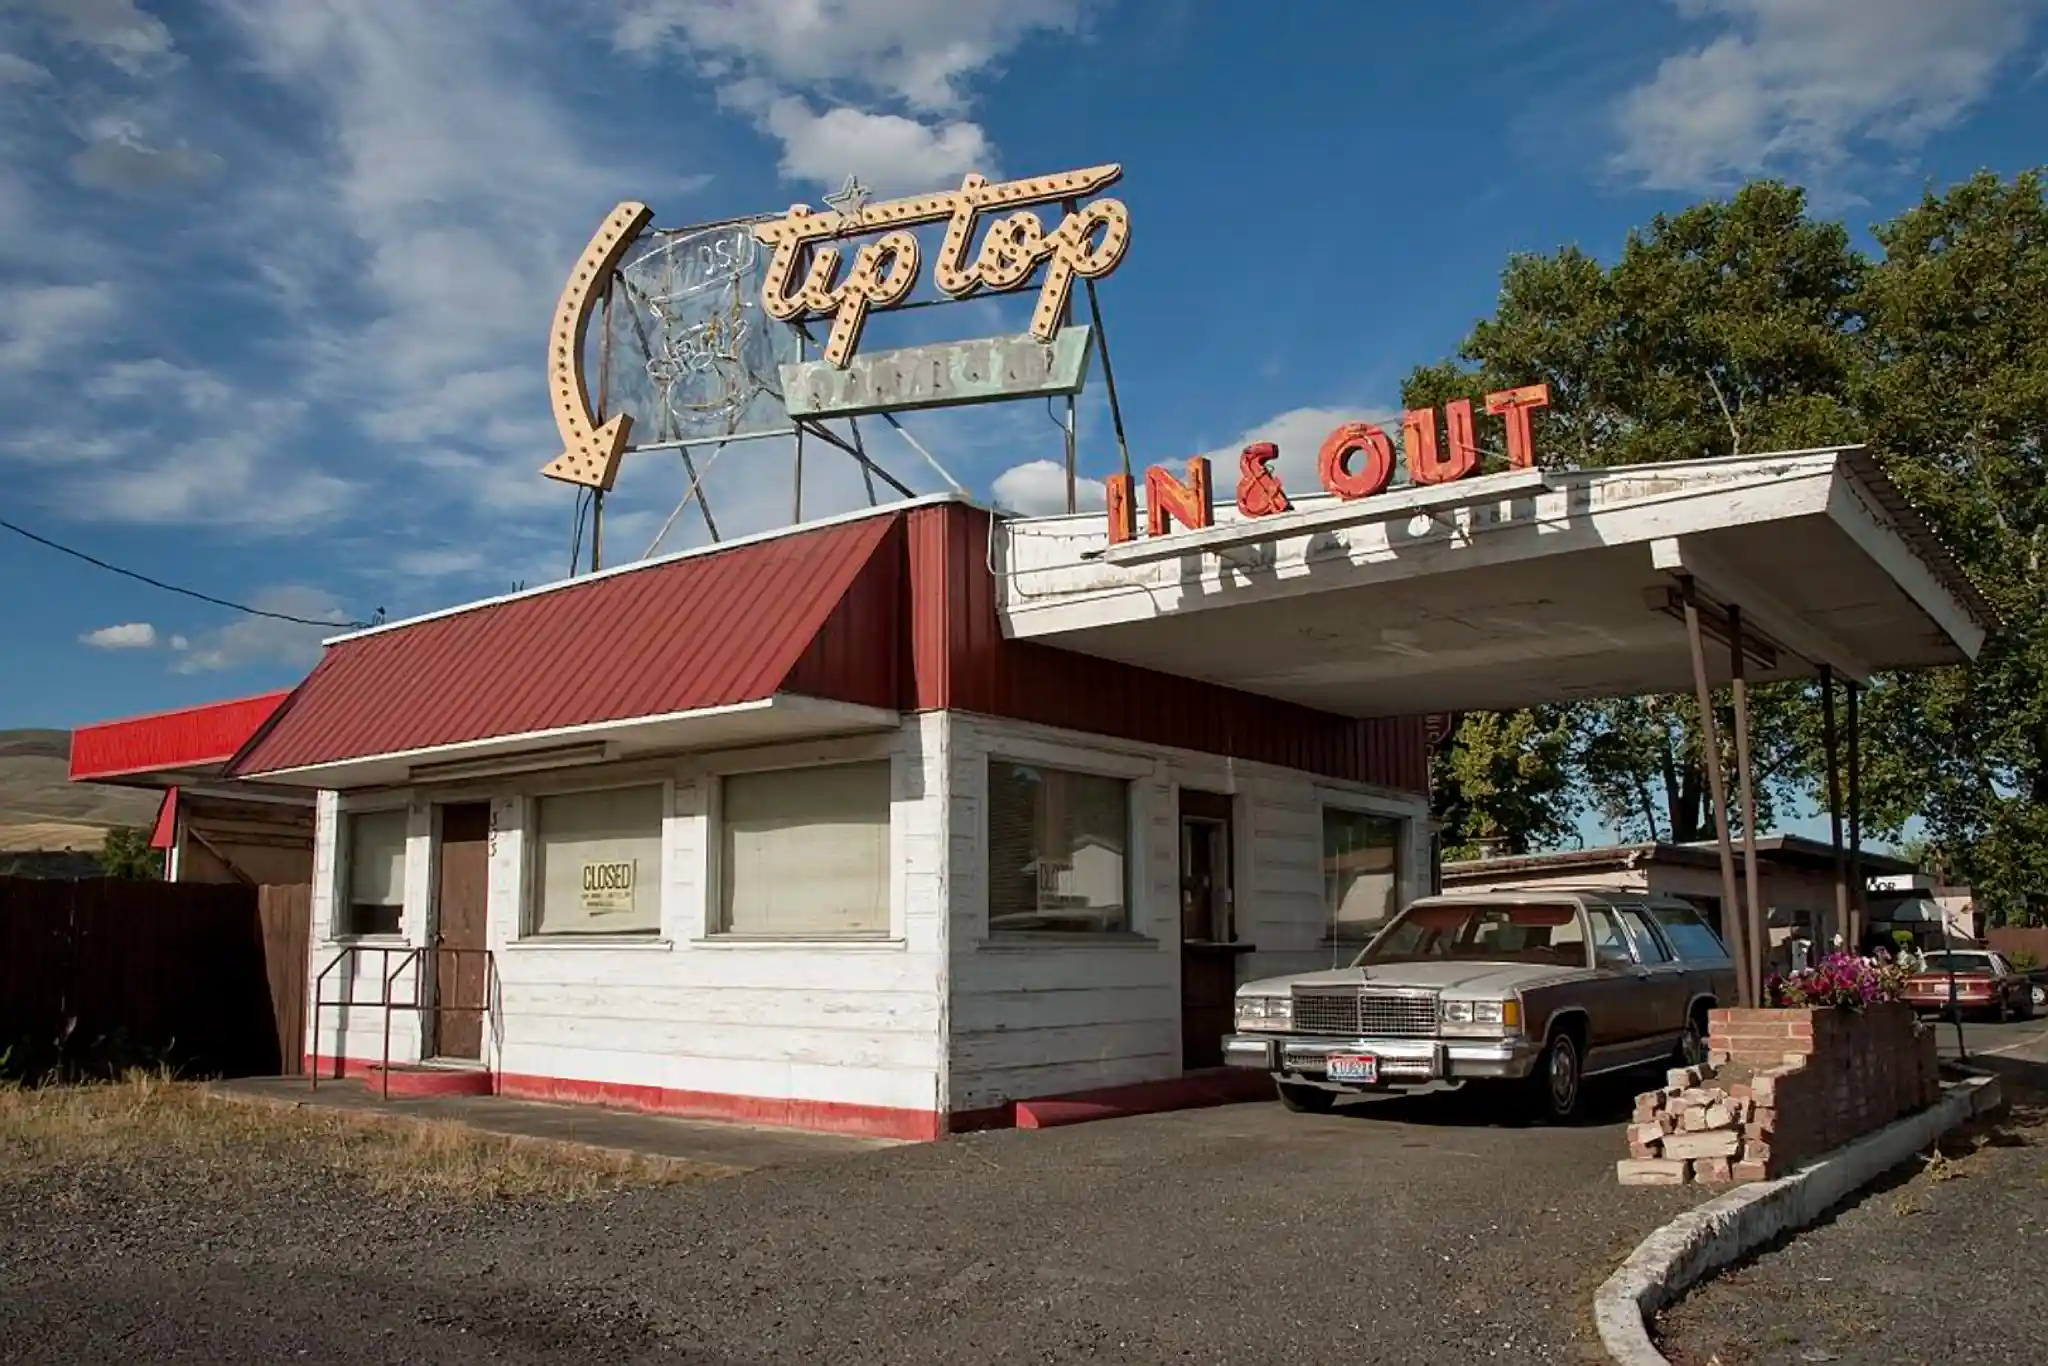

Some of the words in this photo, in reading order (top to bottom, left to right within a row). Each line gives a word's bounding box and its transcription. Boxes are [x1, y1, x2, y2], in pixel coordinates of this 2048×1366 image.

[1106, 456, 1213, 545] IN
[1236, 441, 1294, 518] &
[1317, 384, 1549, 502] OUT
[583, 863, 631, 891] CLOSED
